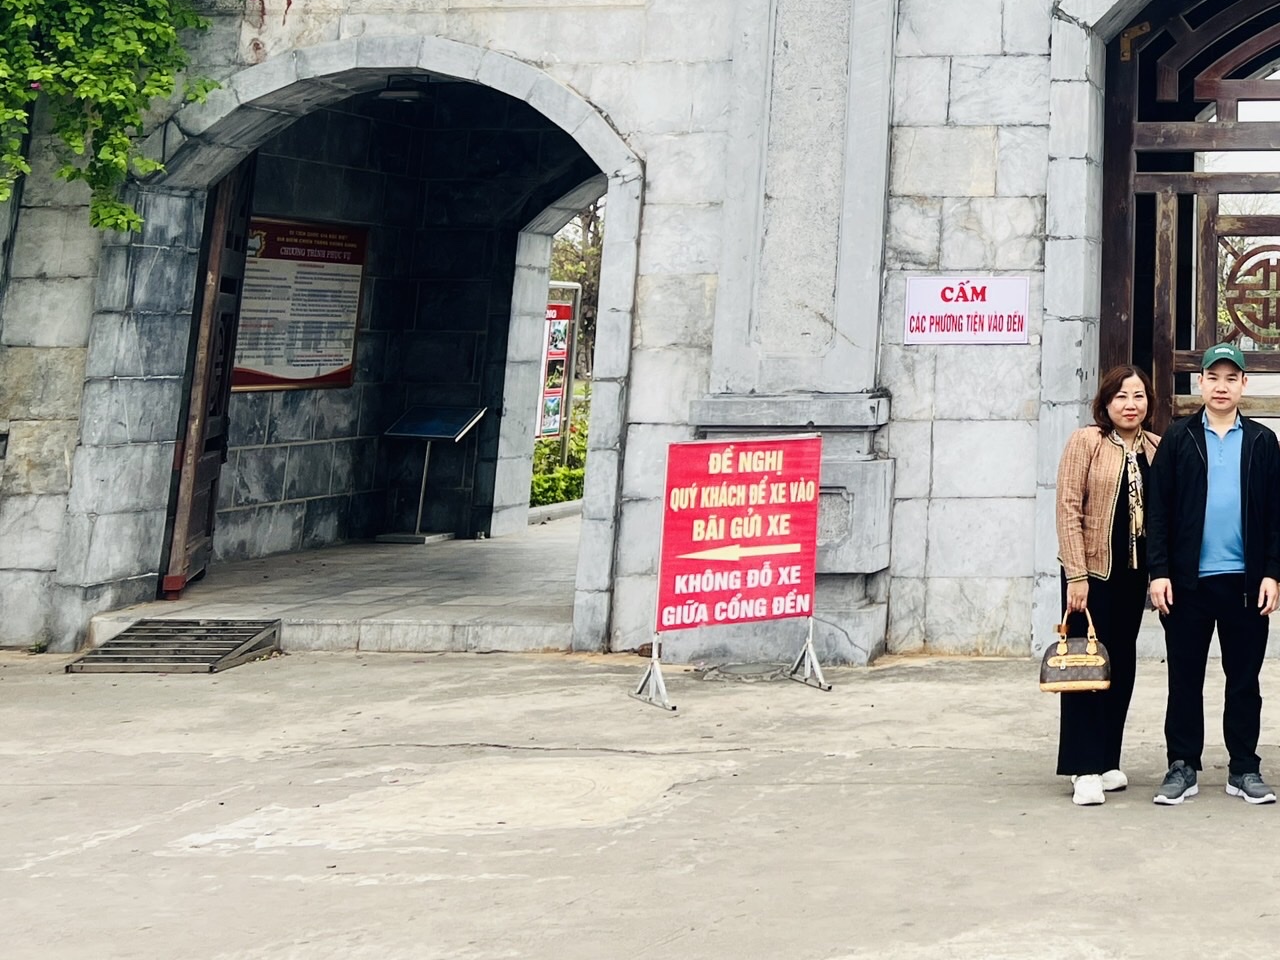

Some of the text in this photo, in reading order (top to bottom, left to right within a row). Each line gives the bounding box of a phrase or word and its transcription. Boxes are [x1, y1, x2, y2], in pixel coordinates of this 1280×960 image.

[940, 280, 987, 303] CẤM
[909, 312, 927, 333] CÁC
[929, 313, 963, 333] PHƯƠNG
[966, 311, 984, 335] TIỆN
[987, 311, 1004, 333] VÀO
[708, 445, 784, 476] ĐỀ NGHỊ
[670, 475, 815, 512] QUÝ KHÁCH ĐỂ XE VÀO
[692, 508, 791, 542] BÃI GỬI XE
[674, 561, 801, 595] KHÔNG ĐỖ XE
[662, 599, 709, 626] GIỮA
[714, 593, 767, 622] CỔNG
